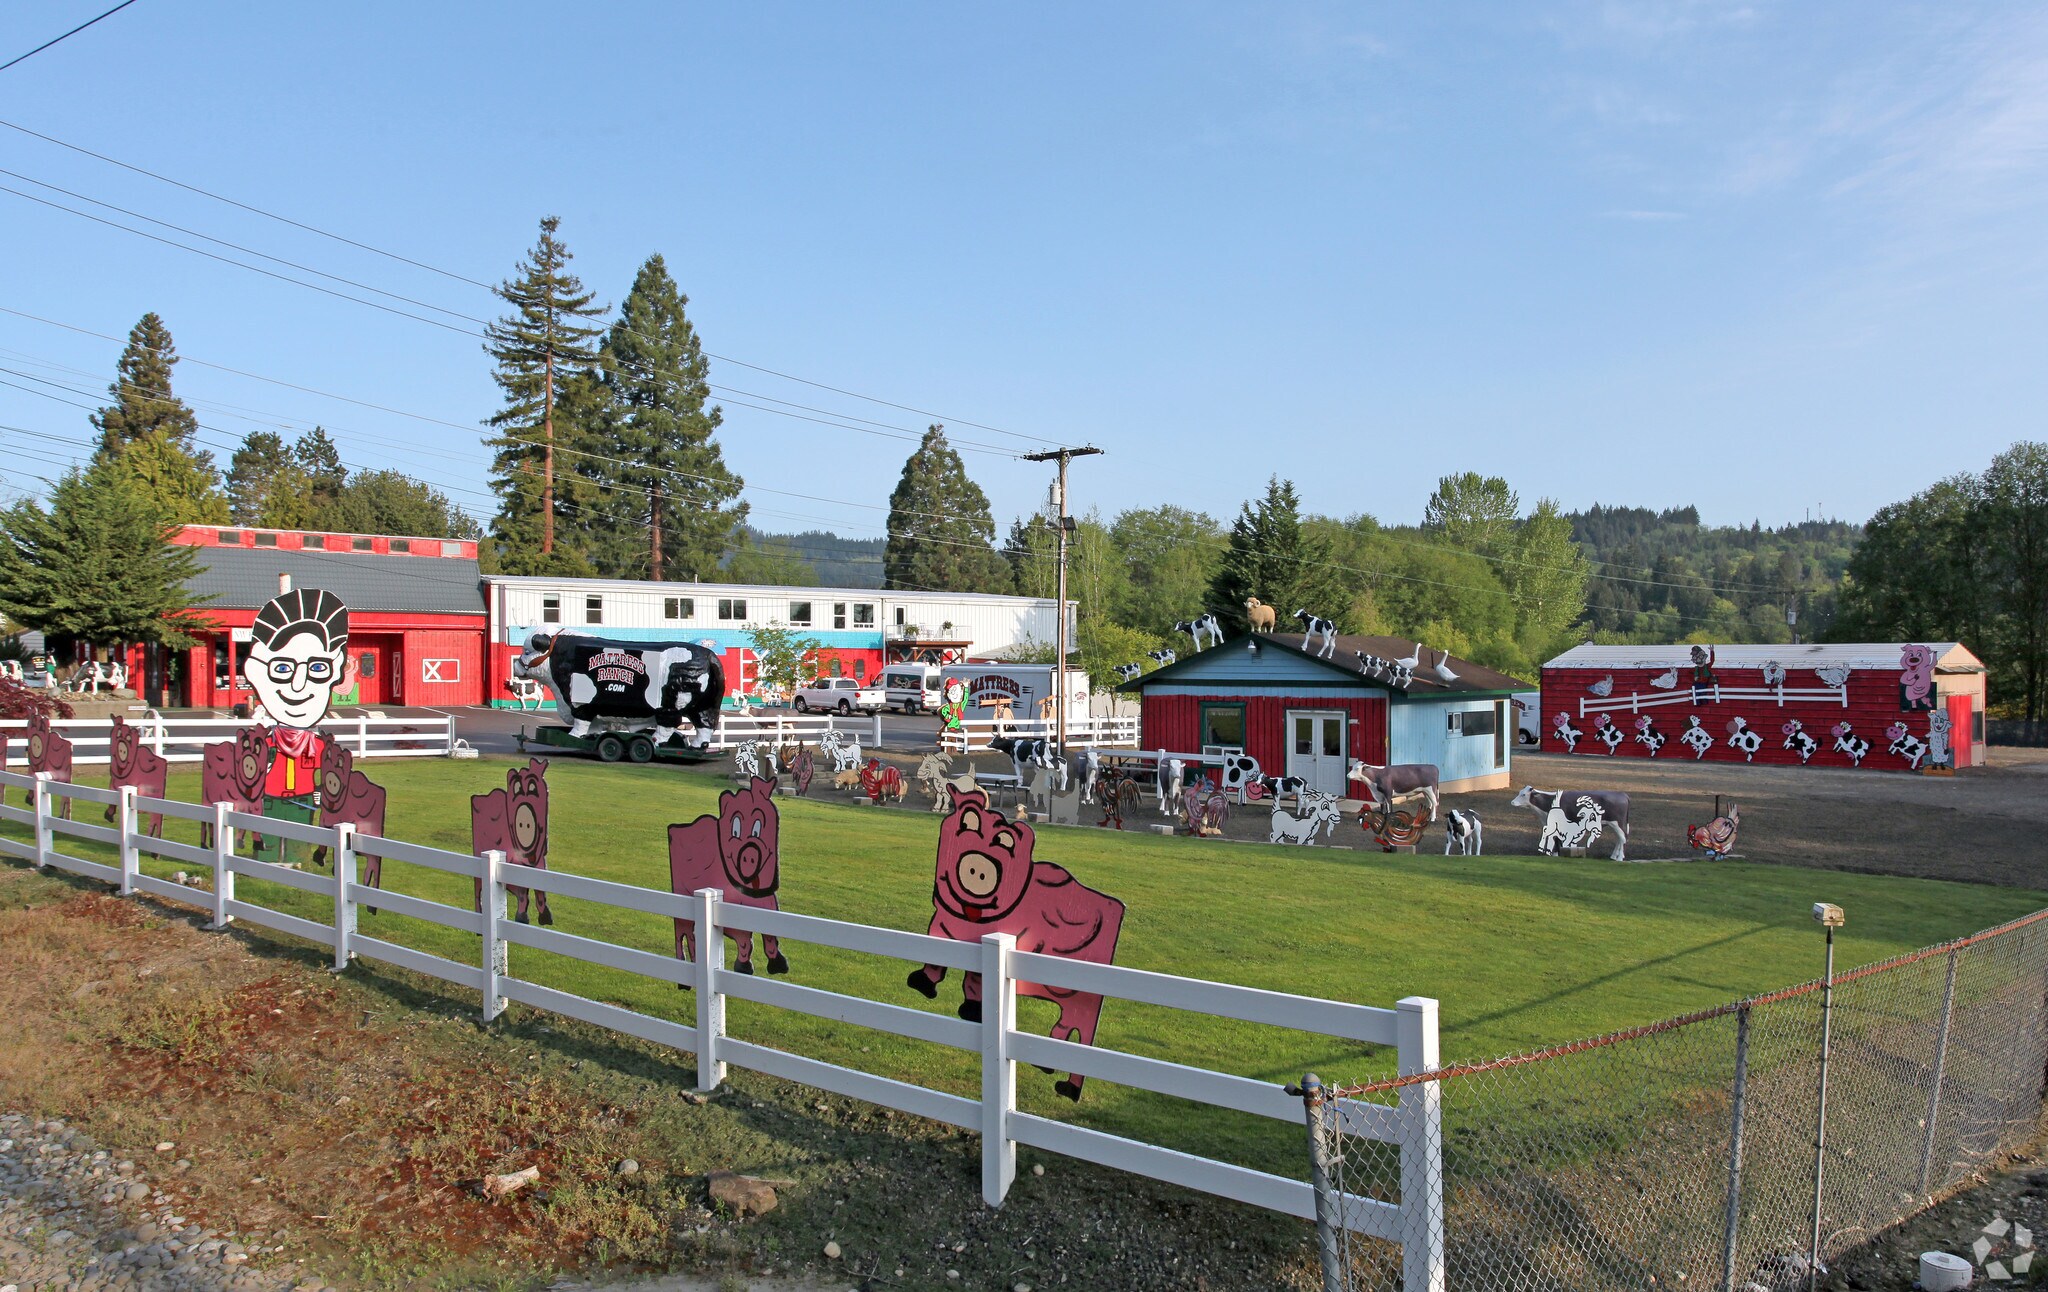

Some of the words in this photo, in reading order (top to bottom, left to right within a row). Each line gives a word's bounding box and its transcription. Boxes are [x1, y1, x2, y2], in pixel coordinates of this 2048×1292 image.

[589, 653, 645, 674] MATTRESS
[597, 667, 634, 685] RANCH
[605, 684, 625, 692] .COM
[970, 675, 1020, 698] MATTRESS
